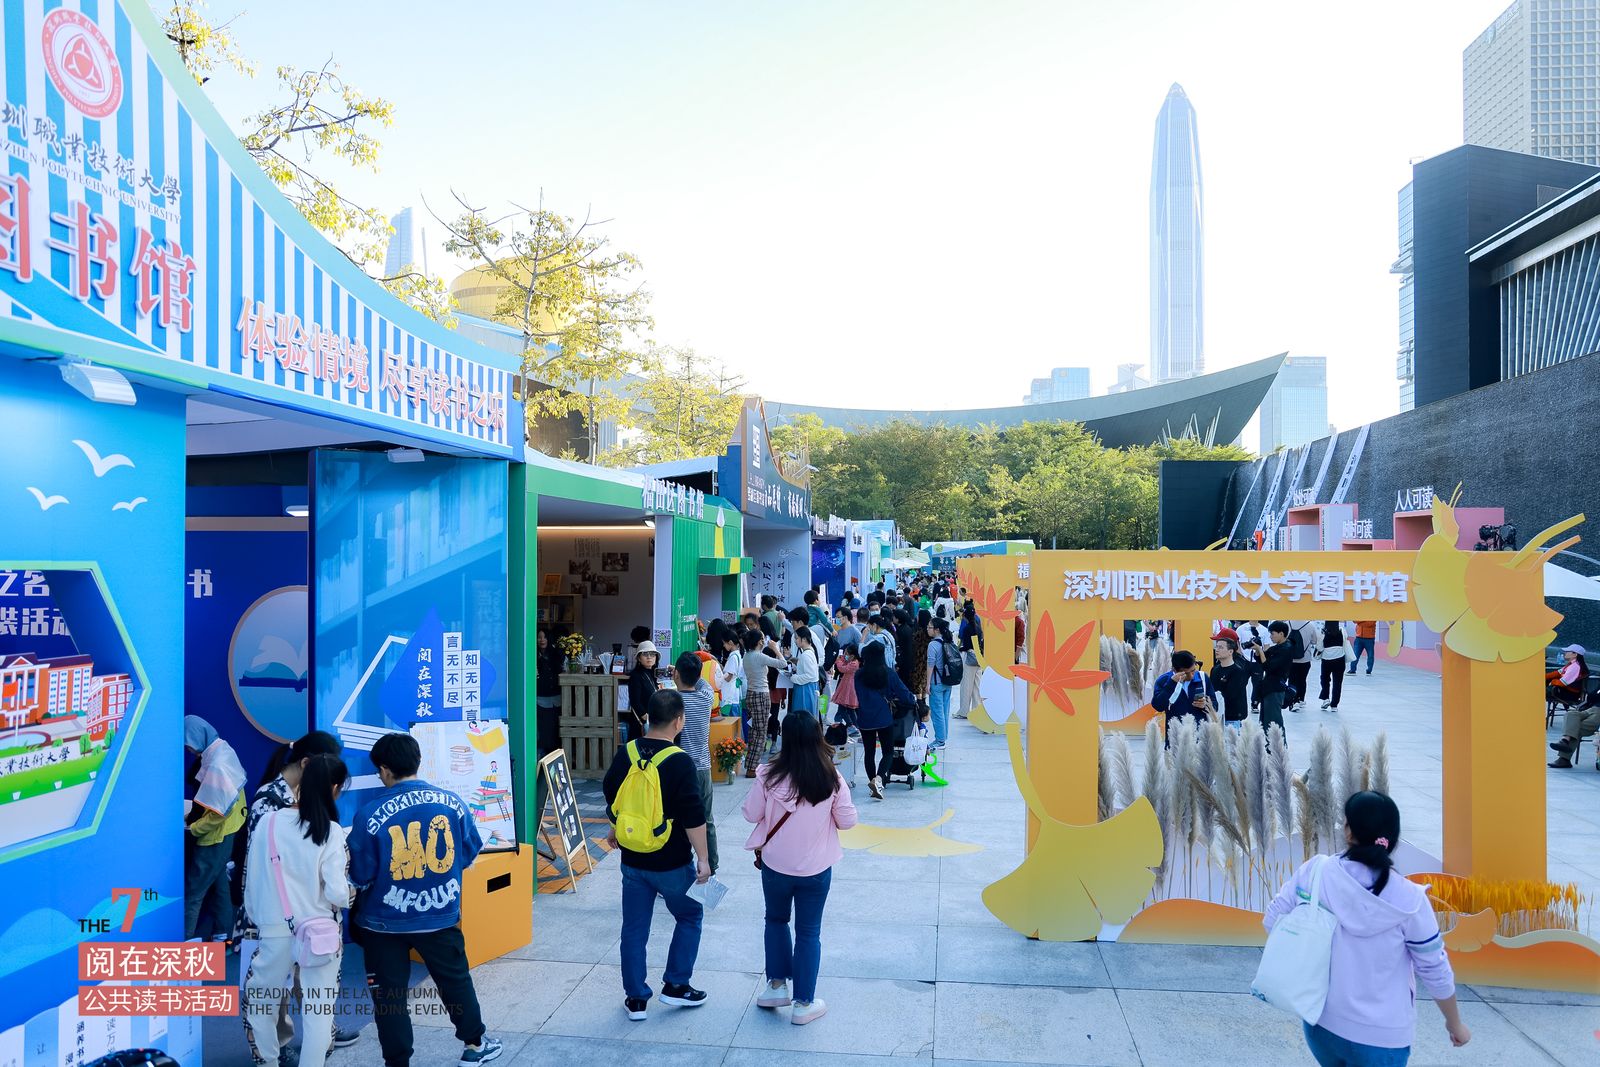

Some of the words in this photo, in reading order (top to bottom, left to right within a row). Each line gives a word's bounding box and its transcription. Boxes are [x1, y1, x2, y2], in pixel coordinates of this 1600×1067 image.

[0, 140, 38, 166] ZHEN
[41, 159, 122, 200] POLYTECHNIC
[121, 192, 181, 225] UNIVERSITY
[237, 296, 370, 393] 体验情境
[379, 349, 505, 431] 尽享读书之乐
[187, 568, 213, 599] 书
[1017, 563, 1031, 580] 福
[1063, 569, 1409, 603] 深圳职业技术大学图书馆
[446, 636, 459, 704] 言无不尽
[465, 653, 478, 721] 知无不言
[0, 746, 70, 775] 業技術大學
[388, 815, 455, 880] MO
